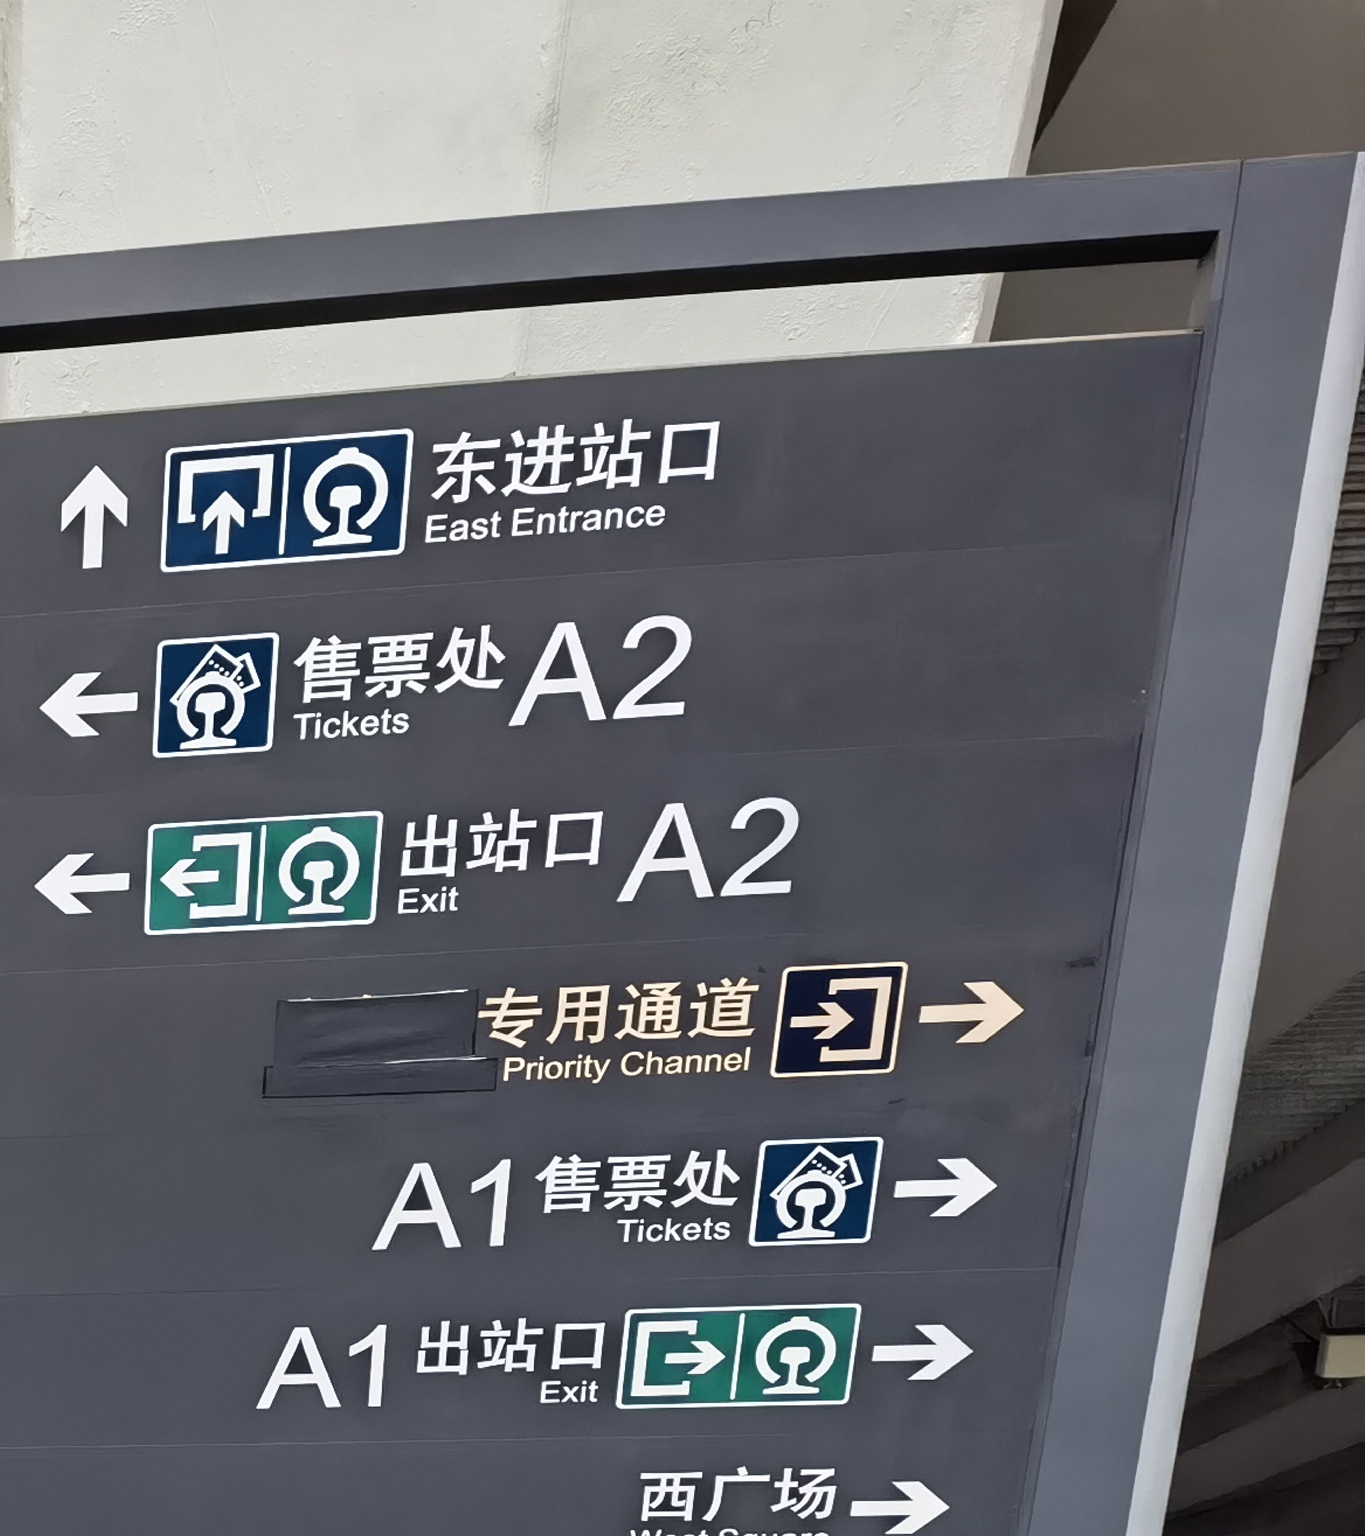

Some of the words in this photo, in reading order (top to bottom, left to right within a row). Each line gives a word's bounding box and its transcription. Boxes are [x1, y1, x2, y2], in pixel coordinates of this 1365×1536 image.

[431, 419, 721, 504] 东进站口
[425, 511, 501, 543] East
[511, 500, 665, 537] Entrance
[294, 625, 505, 703] 售票处
[509, 615, 692, 726] A2
[293, 709, 409, 739] Tickets
[400, 809, 603, 878] 出站口
[617, 797, 799, 902] A2
[397, 887, 459, 915] Exit
[477, 976, 759, 1048] 专用通道
[502, 1053, 611, 1084] Priority
[621, 1046, 750, 1076] Channel
[372, 1159, 511, 1250] A1
[535, 1150, 740, 1214] 售票处
[617, 1217, 730, 1243] Tickets
[256, 1325, 387, 1409] A1
[416, 1317, 606, 1376] 出站口
[539, 1380, 599, 1404] Exit
[639, 1466, 837, 1522] 西广场
